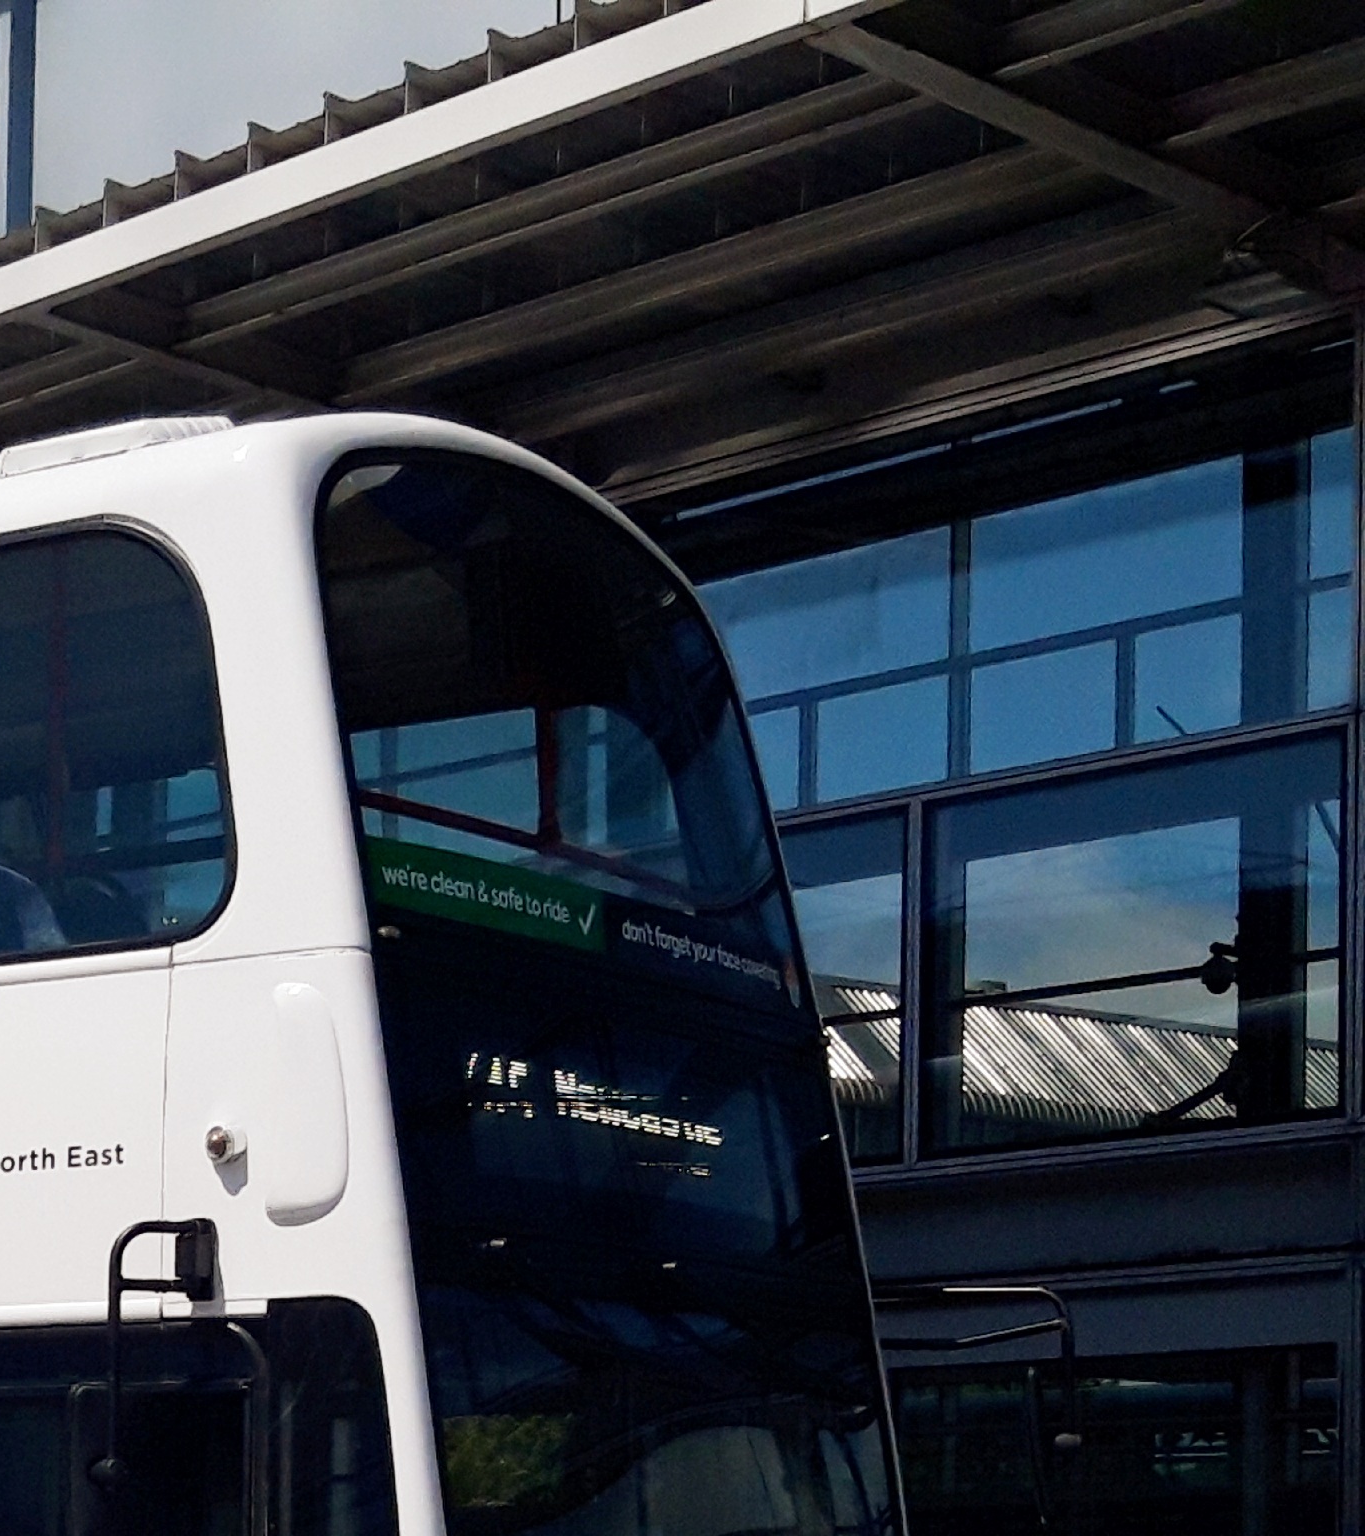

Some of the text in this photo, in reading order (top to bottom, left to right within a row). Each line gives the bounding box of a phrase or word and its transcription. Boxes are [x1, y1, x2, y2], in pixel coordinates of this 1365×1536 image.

[382, 864, 571, 924] we're clean & safe to ride
[622, 919, 655, 947] don't
[655, 925, 692, 959] forget
[692, 942, 717, 963] your
[67, 1144, 125, 1168] East
